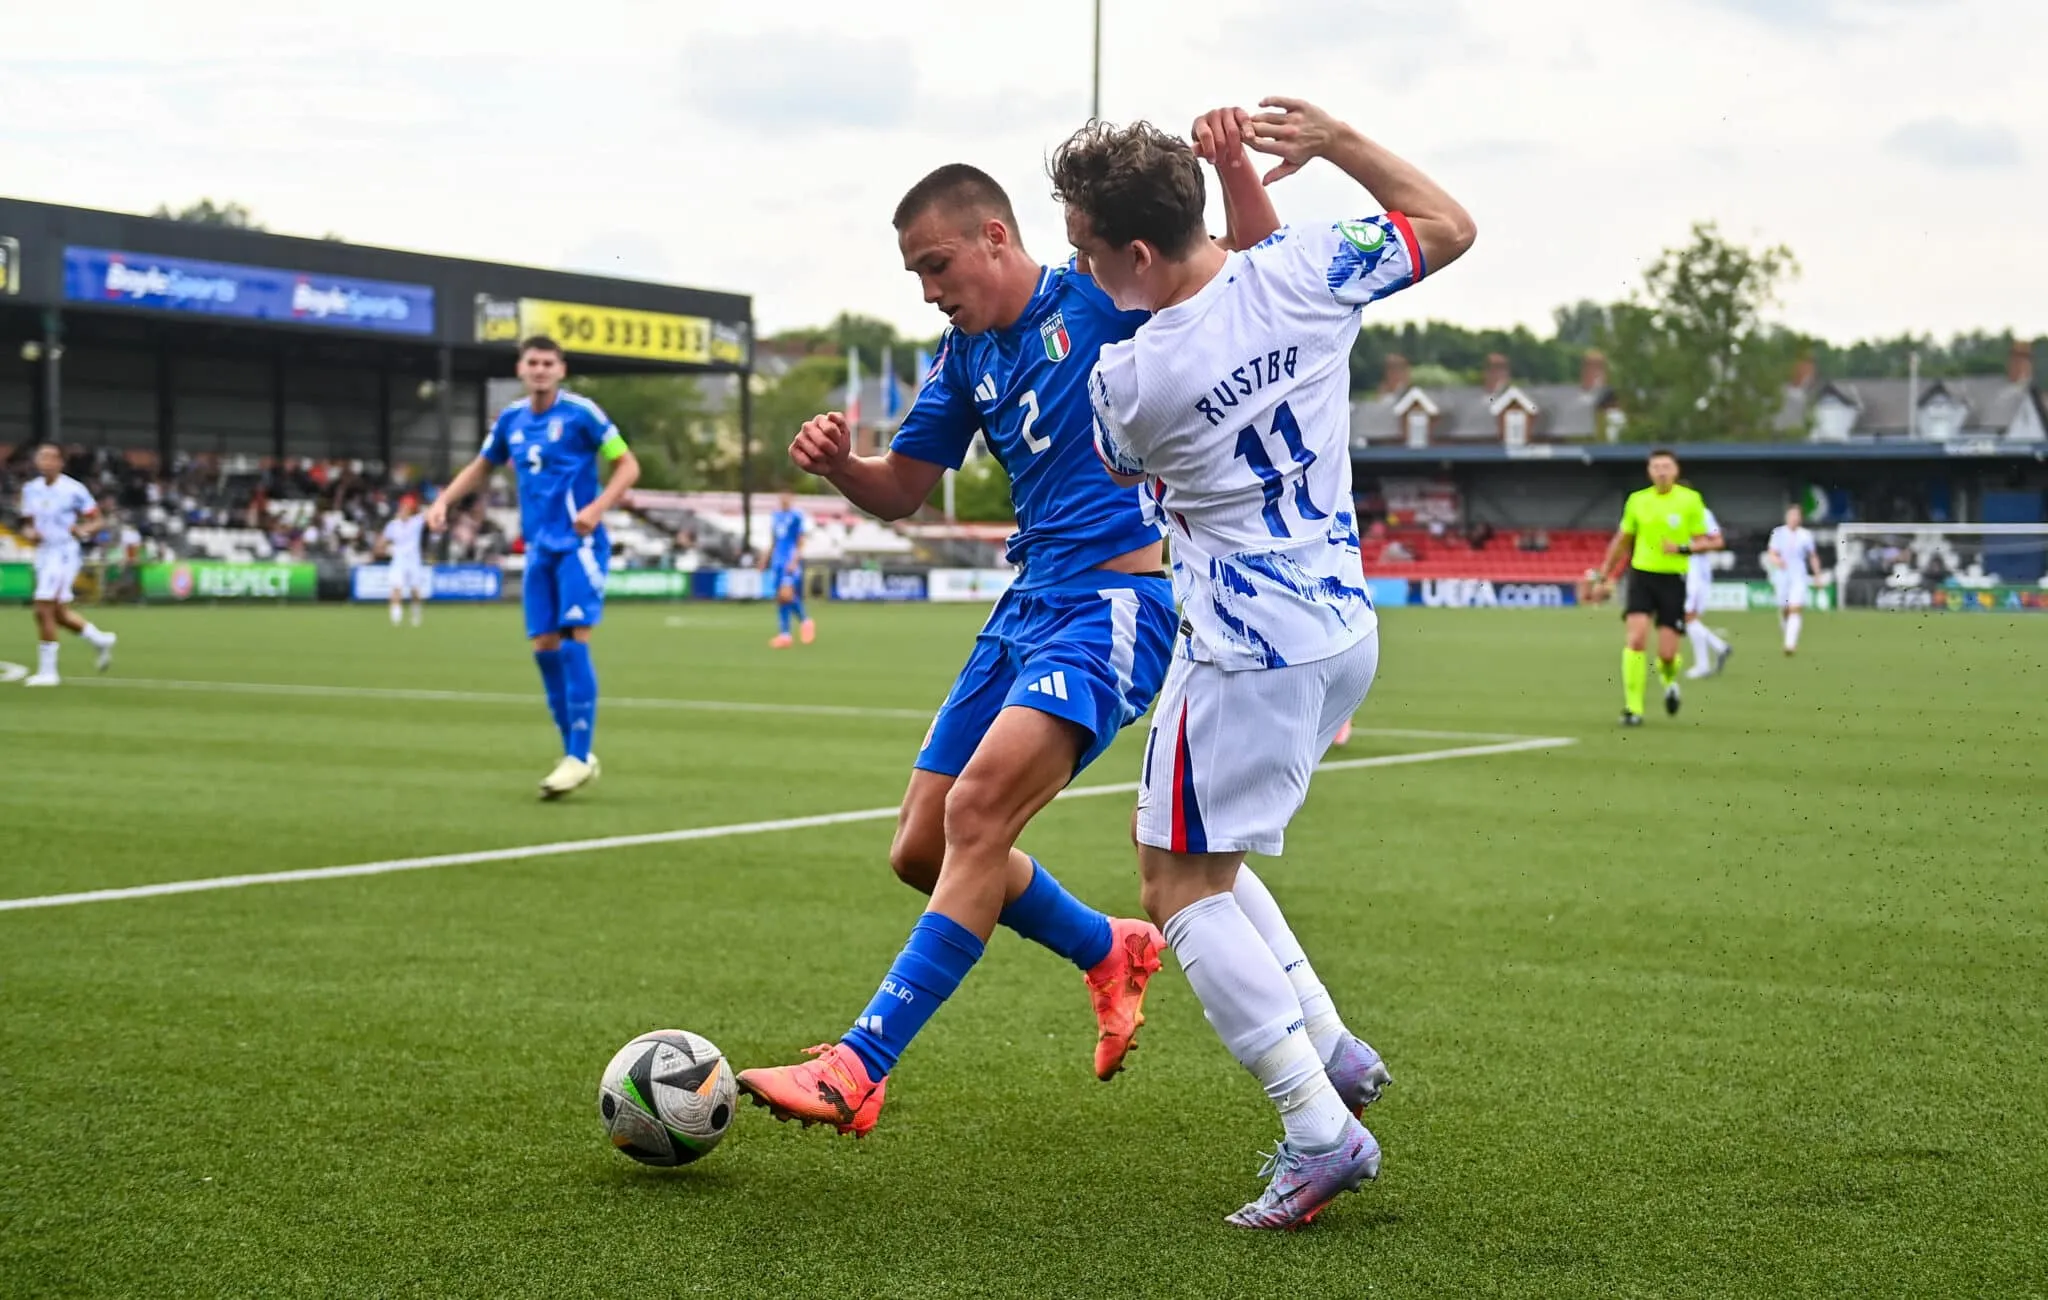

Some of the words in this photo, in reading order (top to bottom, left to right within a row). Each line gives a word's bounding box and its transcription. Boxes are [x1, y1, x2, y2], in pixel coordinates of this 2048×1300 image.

[556, 313, 595, 342] 90
[1018, 389, 1052, 455] 2
[528, 444, 543, 475] 5
[1233, 400, 1329, 538] 11
[200, 566, 292, 597] RESPECT
